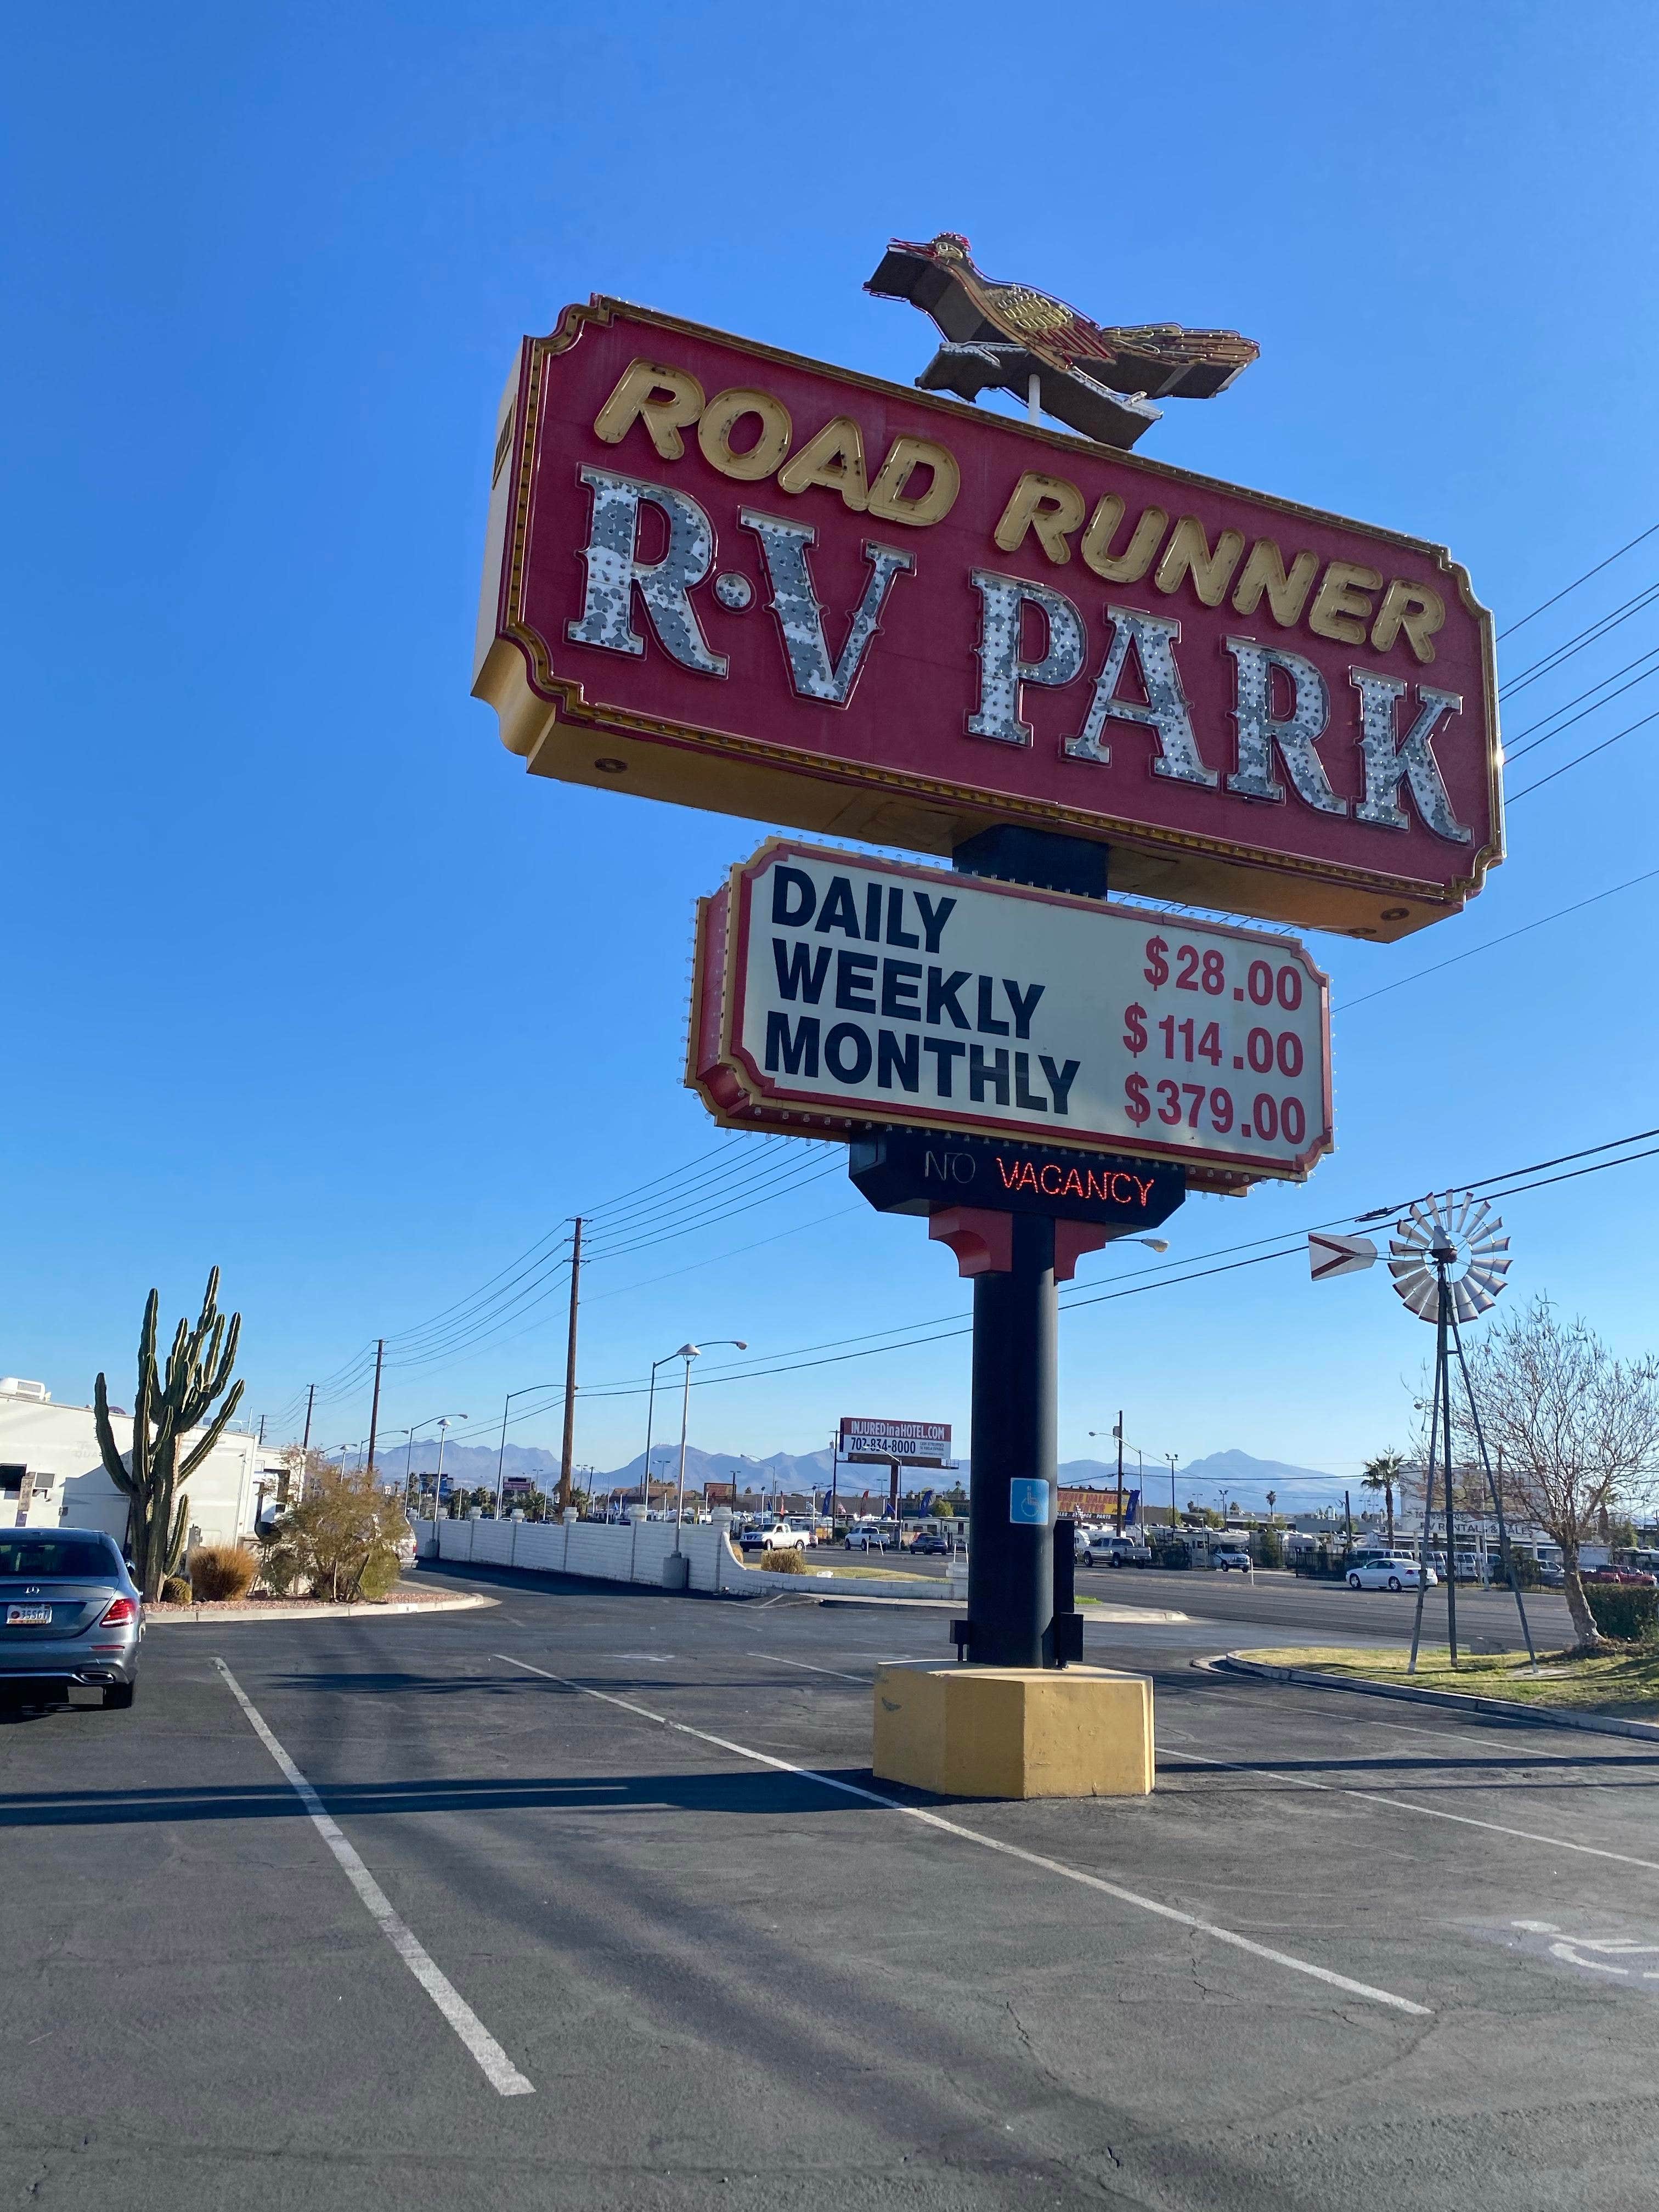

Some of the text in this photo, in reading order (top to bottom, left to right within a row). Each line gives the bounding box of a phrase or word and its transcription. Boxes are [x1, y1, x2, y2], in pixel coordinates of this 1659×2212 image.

[594, 357, 1445, 663] ROAD RUNNER
[963, 567, 1474, 847] PARK
[771, 865, 1303, 1011] DAILY $28.00
[772, 938, 1046, 1040] WEEKLY
[765, 1011, 1306, 1144] MONTHLY $379.00
[924, 1151, 1154, 1206] NO VACANCY
[851, 1437, 916, 1454] 702-834-8000
